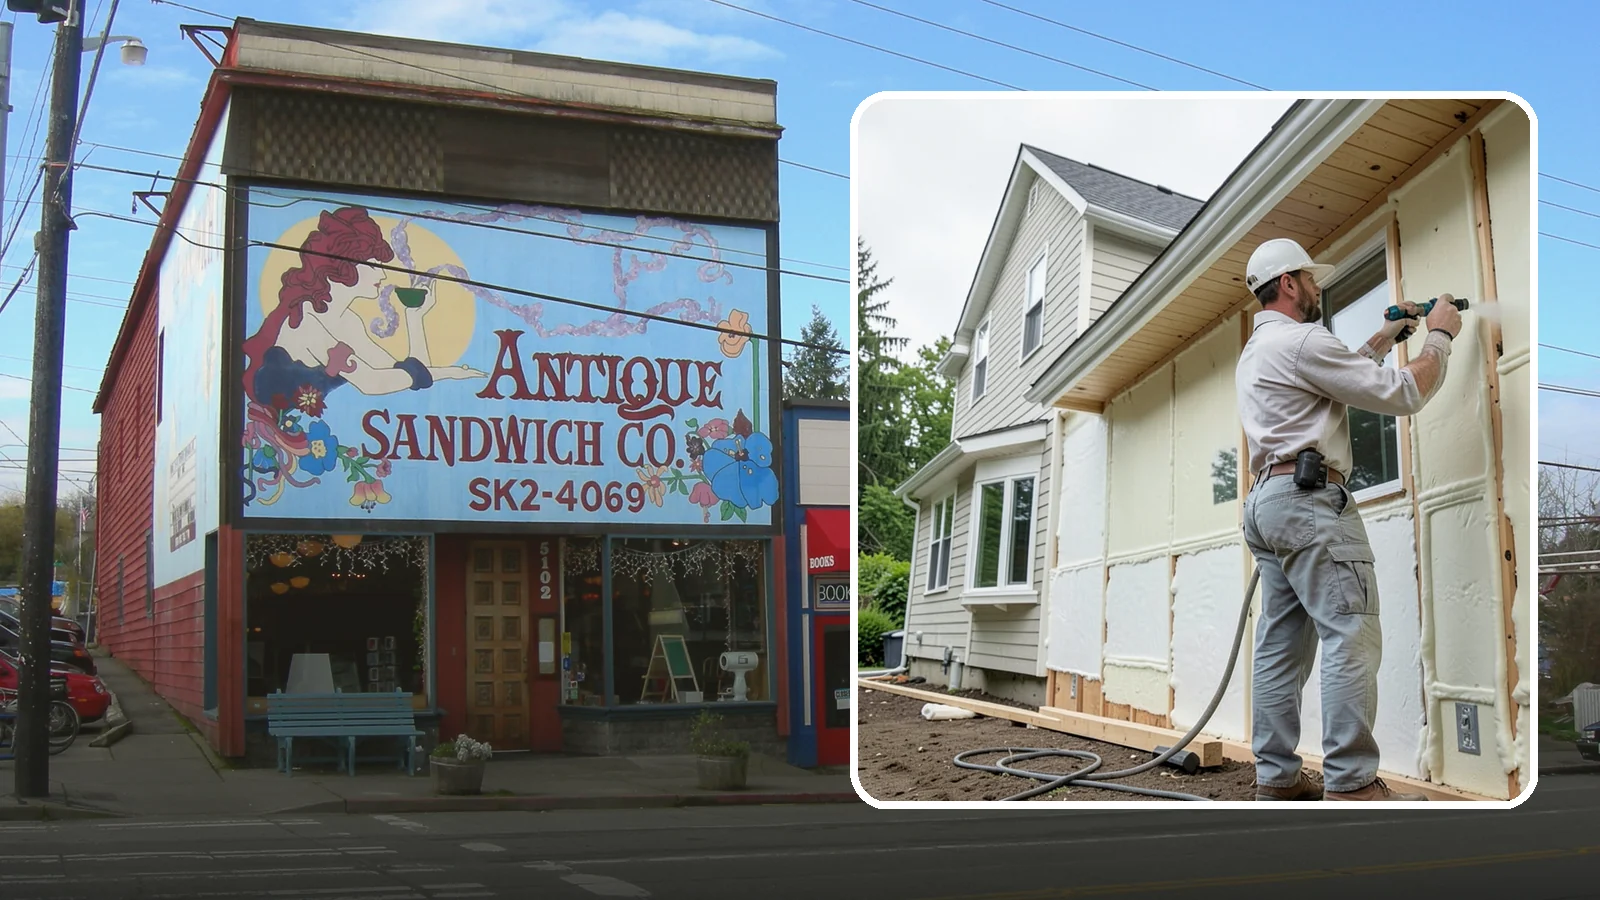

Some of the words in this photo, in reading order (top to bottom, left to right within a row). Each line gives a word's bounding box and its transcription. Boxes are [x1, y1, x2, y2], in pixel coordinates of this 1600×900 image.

[475, 328, 724, 421] ANTIQUE
[361, 408, 605, 467] SANDWICH
[616, 421, 686, 469] CO.
[468, 476, 646, 513] SK2-4069
[539, 541, 552, 600] 5102
[809, 555, 835, 569] BOOKS
